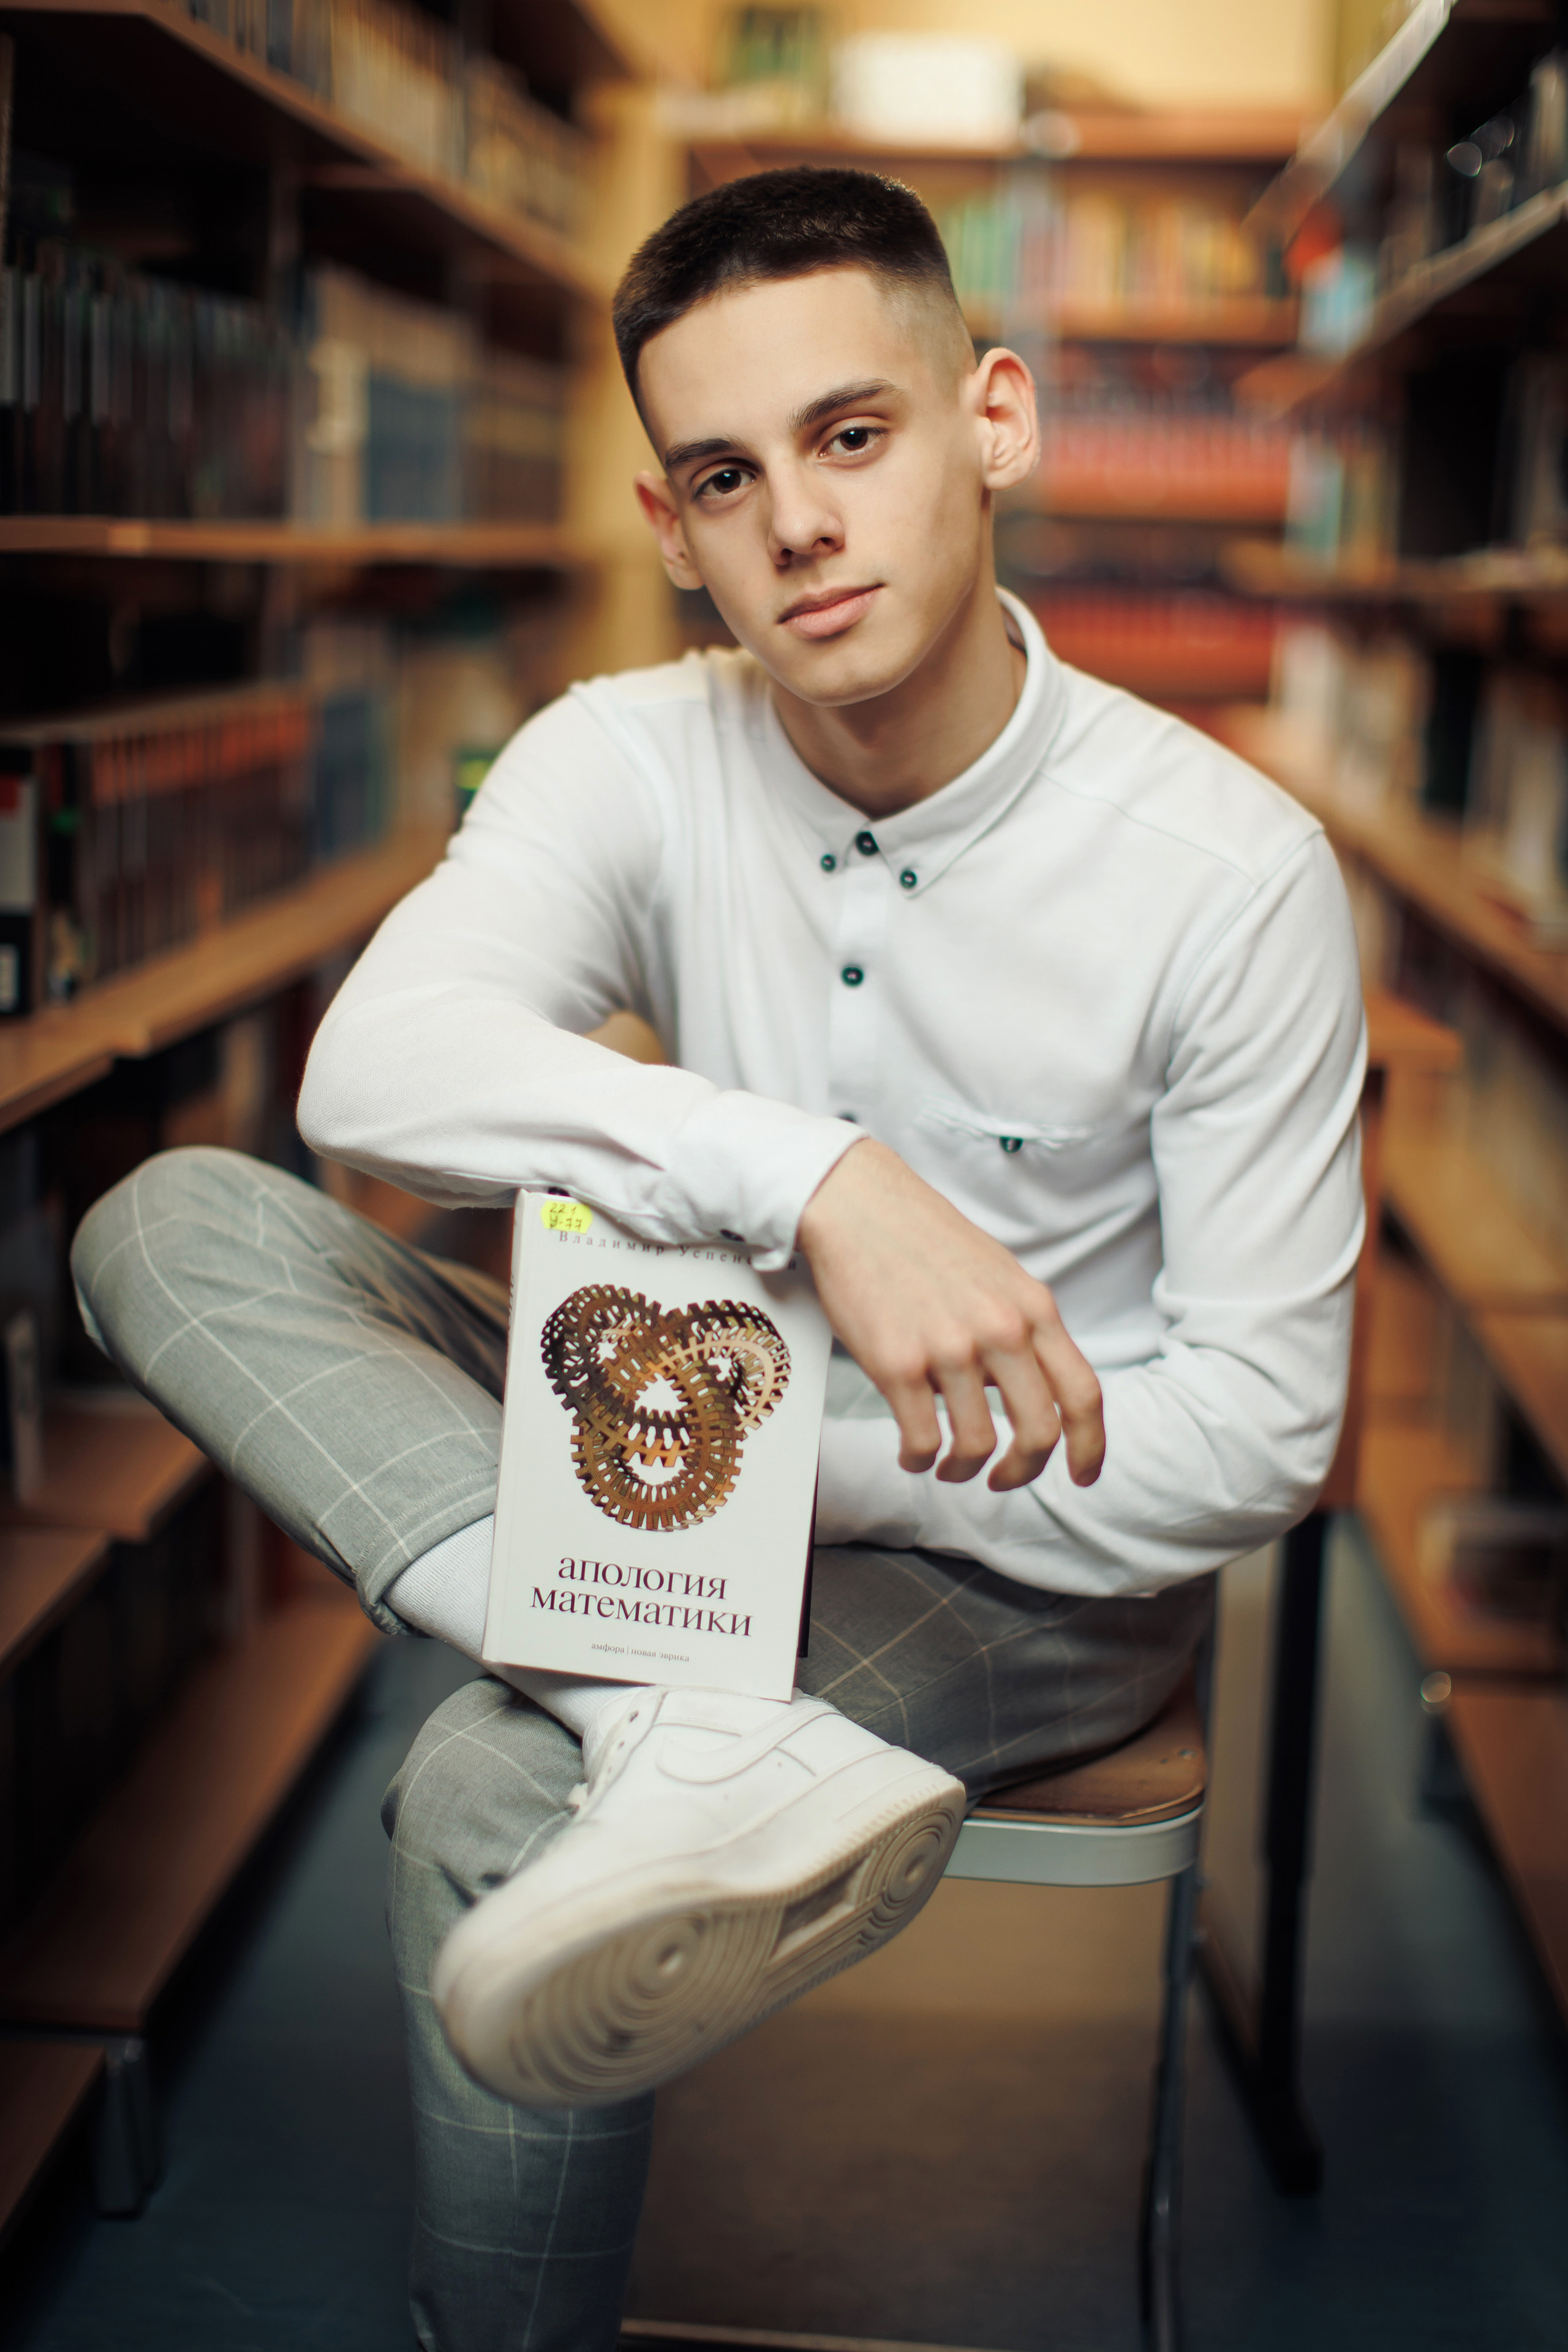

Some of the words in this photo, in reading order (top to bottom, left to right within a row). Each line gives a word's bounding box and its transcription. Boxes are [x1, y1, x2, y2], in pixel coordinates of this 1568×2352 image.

[559, 1231, 665, 1256] Владимир
[558, 1557, 729, 1600] апология
[529, 1586, 754, 1637] математики
[591, 1643, 625, 1653] амфора
[631, 1648, 657, 1657] новая
[659, 1651, 690, 1662] эврика
